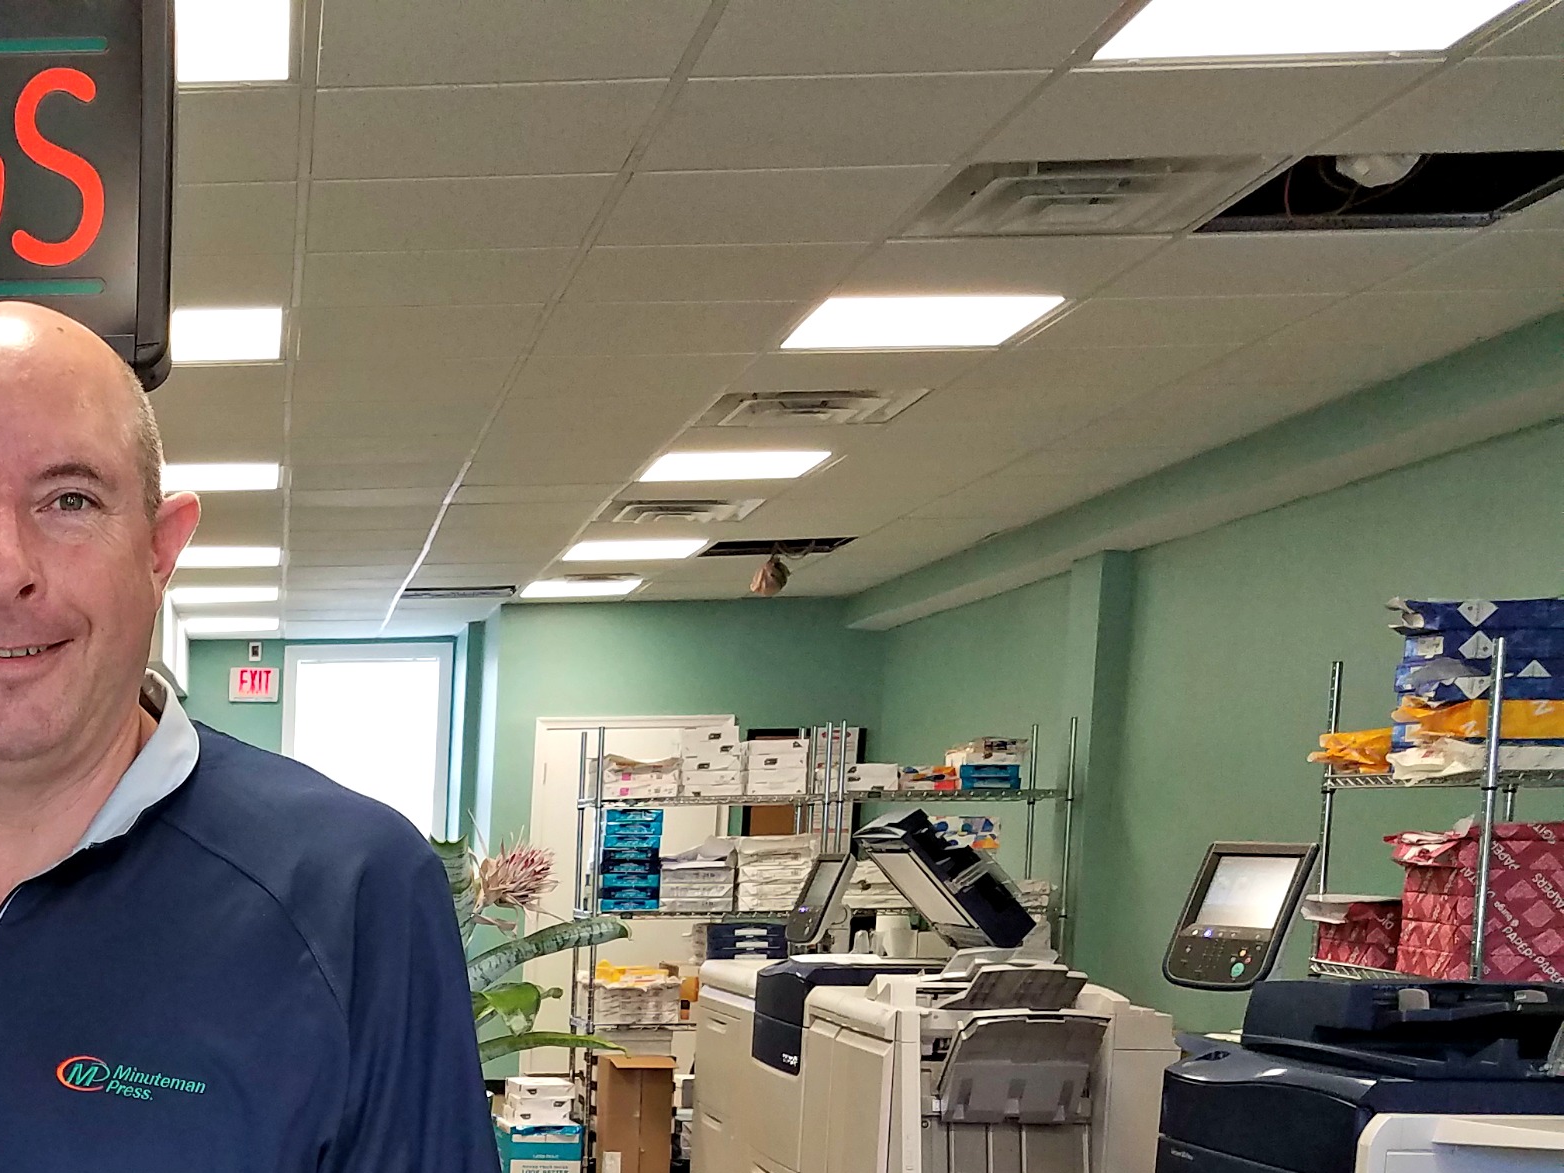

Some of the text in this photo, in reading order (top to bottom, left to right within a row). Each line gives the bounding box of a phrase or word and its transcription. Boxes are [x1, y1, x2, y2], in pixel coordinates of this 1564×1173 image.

[238, 669, 272, 695] EXIT
[106, 1080, 153, 1101] Press.
[113, 1065, 206, 1094] Minuteman
